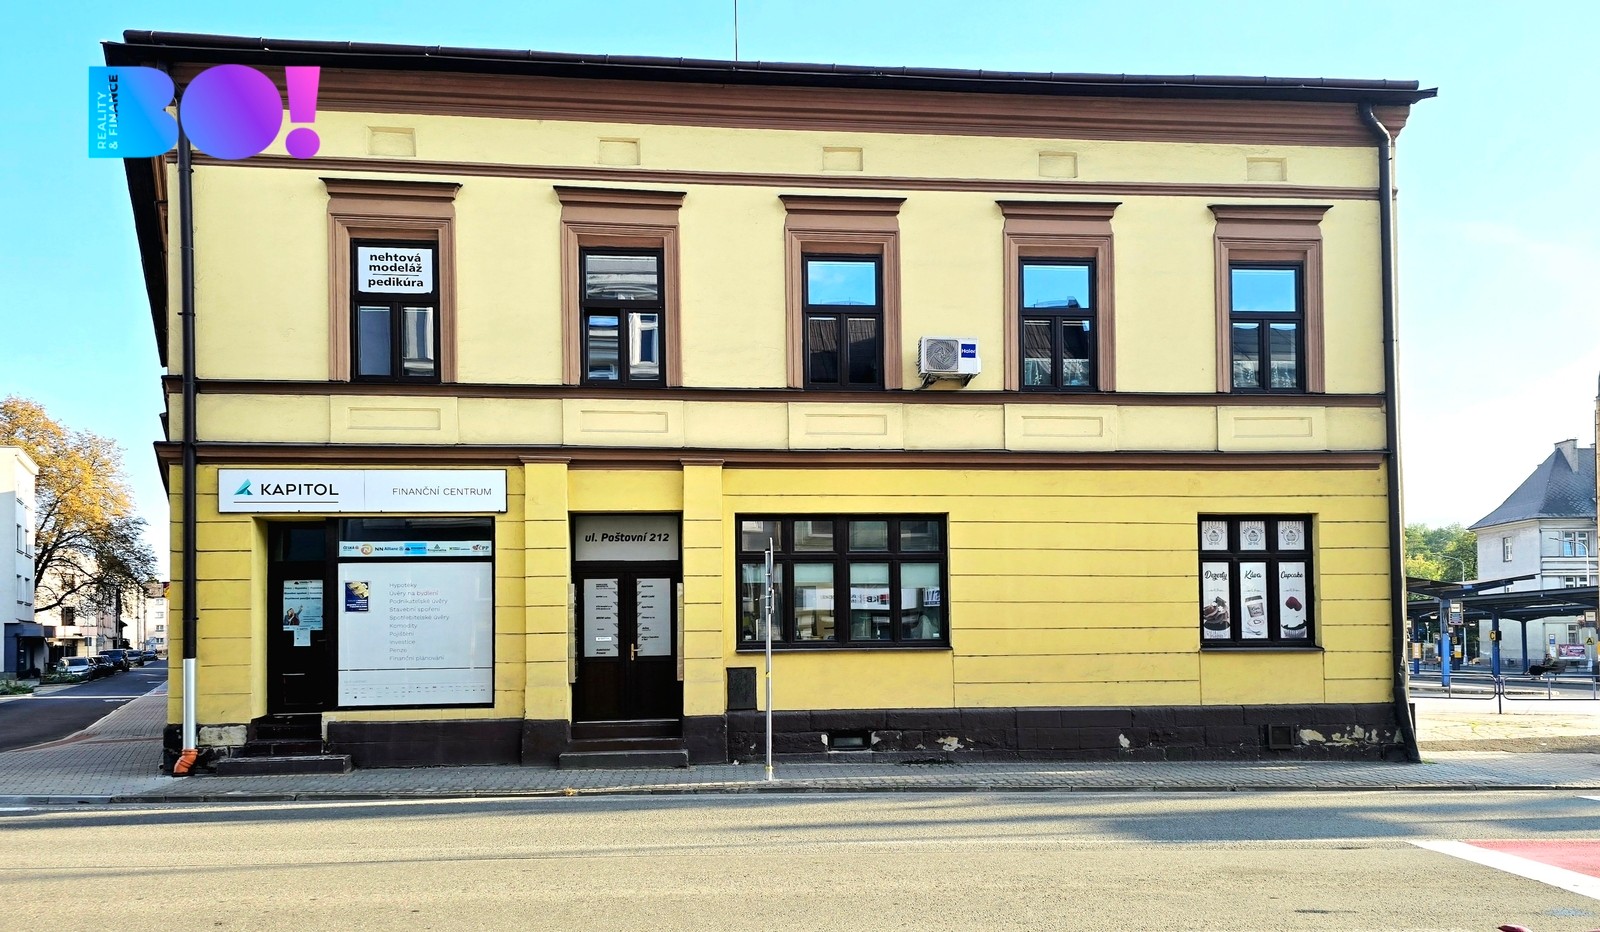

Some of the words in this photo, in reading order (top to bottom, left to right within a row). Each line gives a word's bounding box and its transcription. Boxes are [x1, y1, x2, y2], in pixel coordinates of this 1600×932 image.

[370, 252, 421, 262] nehtová
[369, 263, 422, 273] modeláž
[368, 277, 424, 288] pedikúra
[260, 483, 339, 496] KAPITOL
[392, 486, 440, 496] FINANČNÍ
[443, 487, 492, 496] CENTRUM
[585, 532, 598, 542] ul.
[601, 532, 648, 542] Poštovní
[649, 533, 670, 542] 212
[1280, 571, 1303, 580] Cupcake
